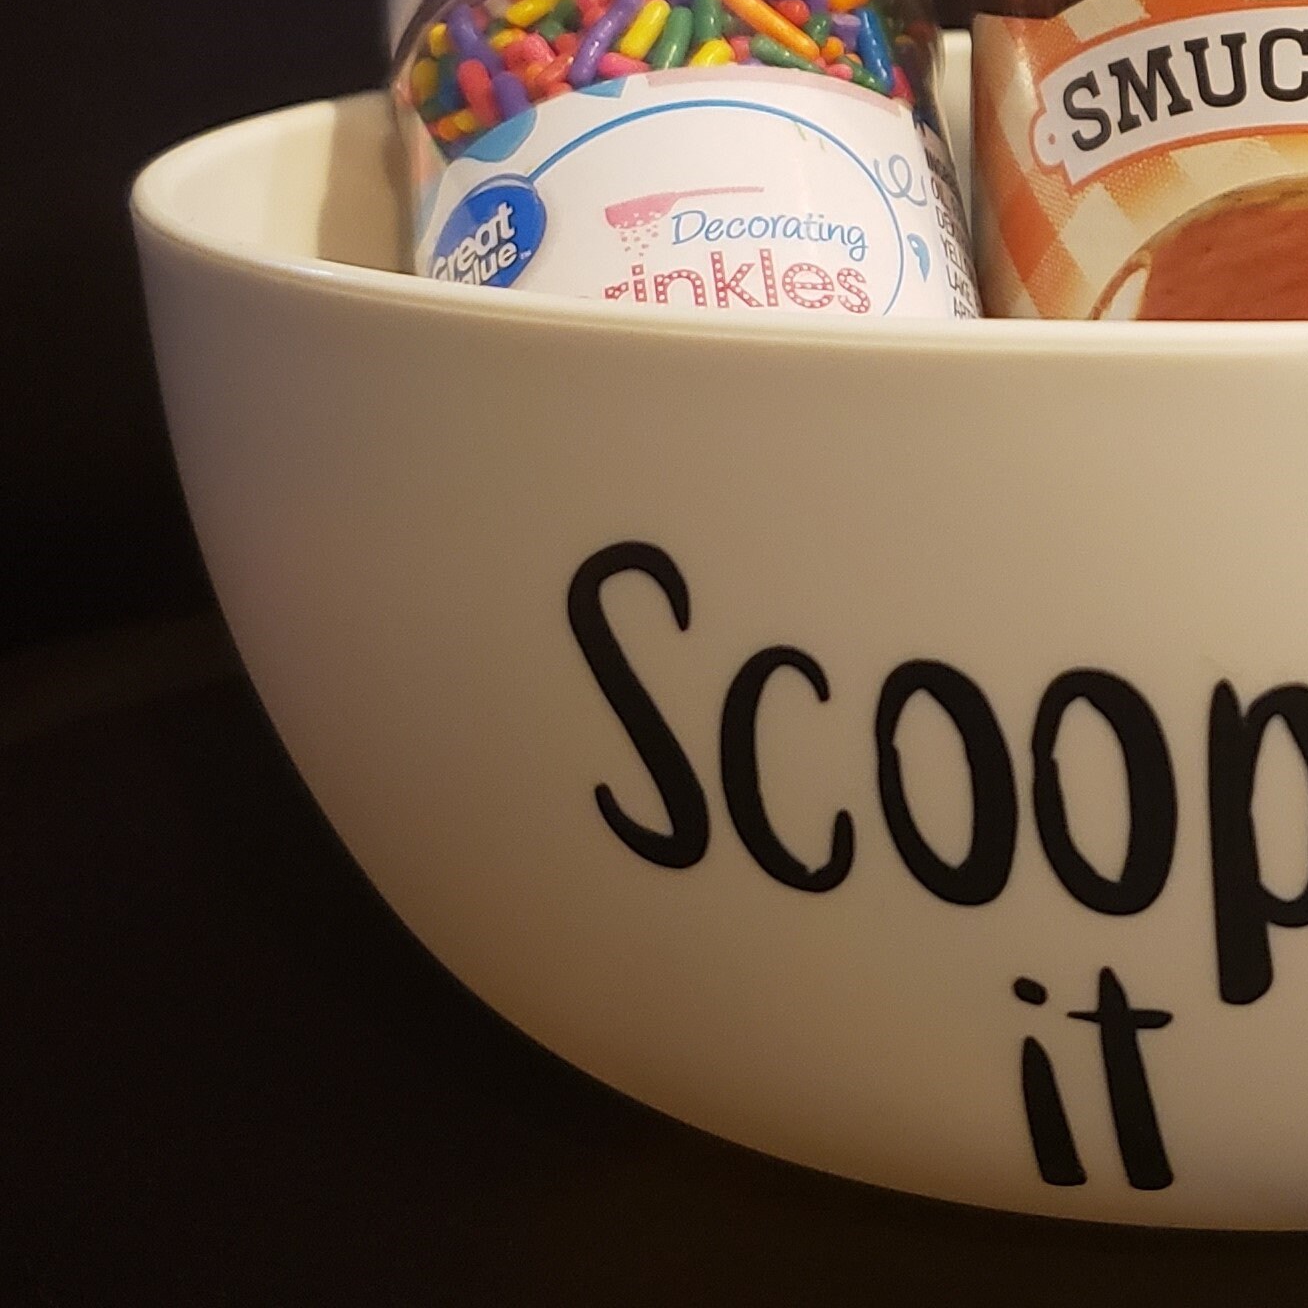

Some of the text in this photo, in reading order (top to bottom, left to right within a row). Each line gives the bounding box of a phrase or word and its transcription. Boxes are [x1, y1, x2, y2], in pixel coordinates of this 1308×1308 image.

[671, 209, 869, 263] Decorating
[603, 248, 872, 315] rinkles
[1011, 965, 1178, 1192] it
